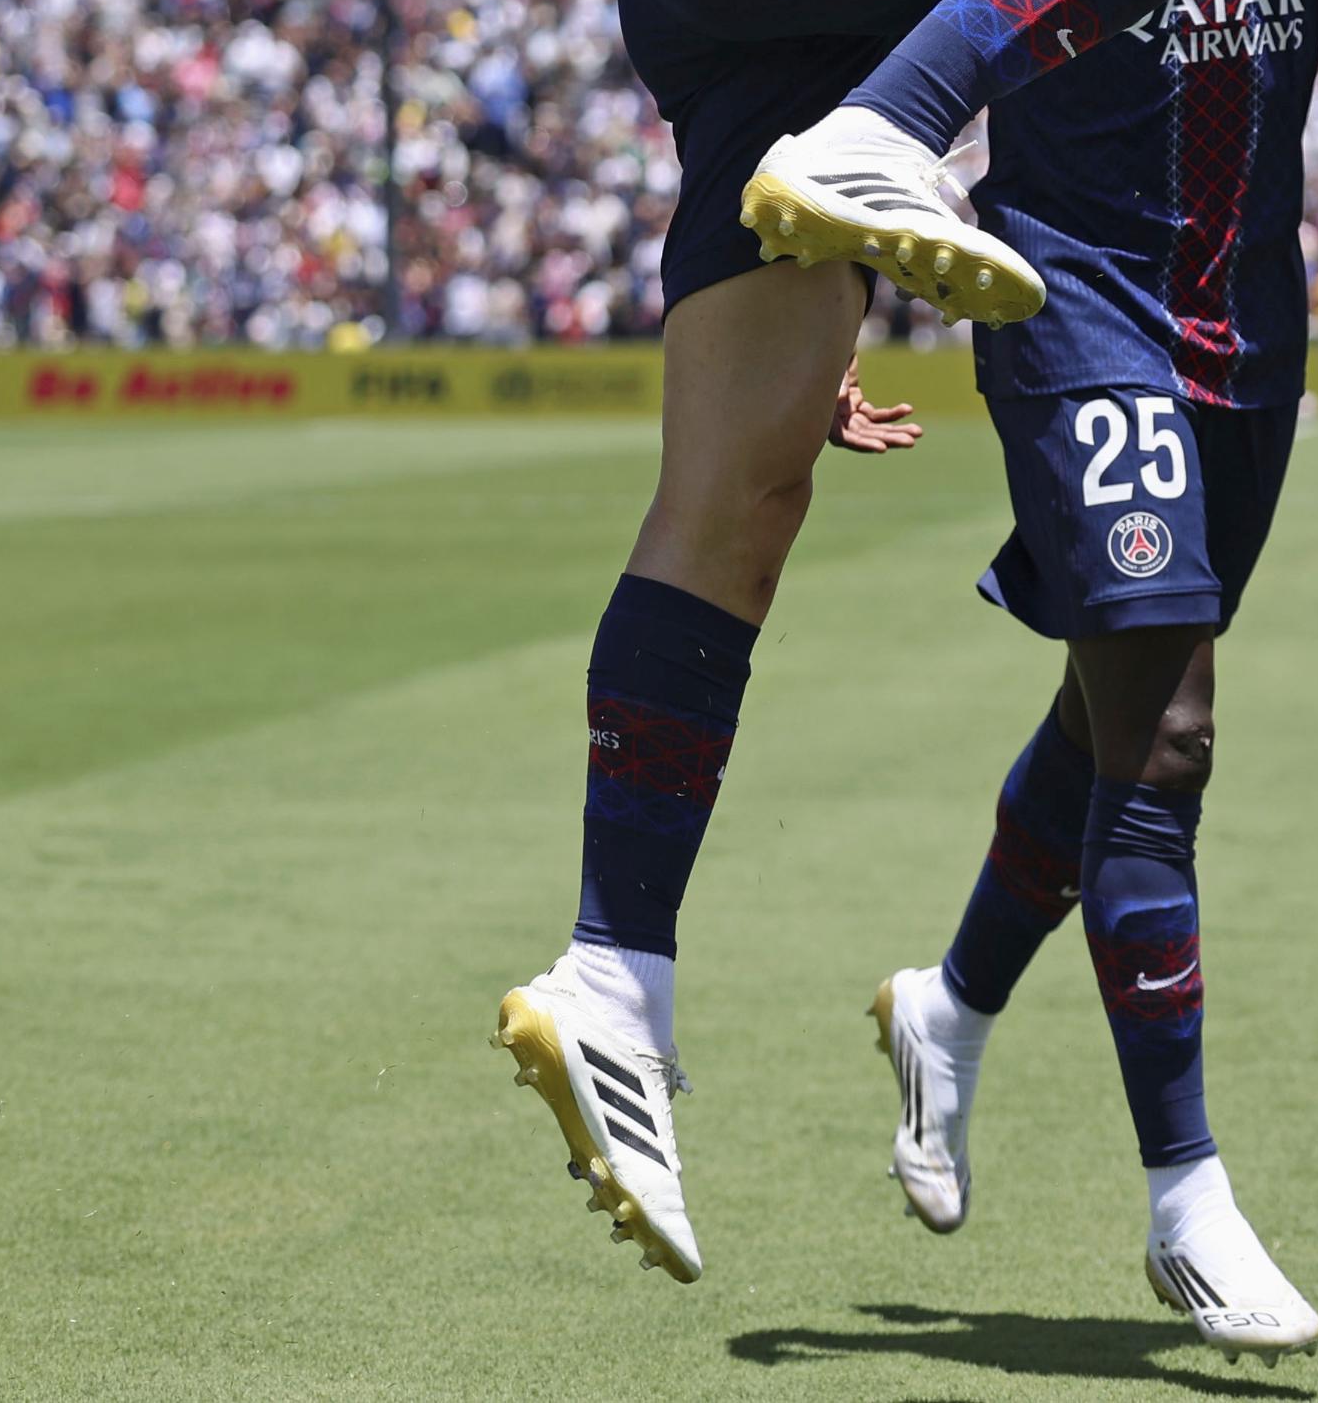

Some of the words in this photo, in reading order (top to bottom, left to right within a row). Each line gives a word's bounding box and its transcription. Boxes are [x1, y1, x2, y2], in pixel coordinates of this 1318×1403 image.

[1159, 17, 1304, 65] AIRWAYS
[1074, 397, 1187, 507] 25
[1117, 515, 1158, 534] PARIS
[589, 728, 620, 749] RIS
[1202, 1312, 1280, 1331] F50
